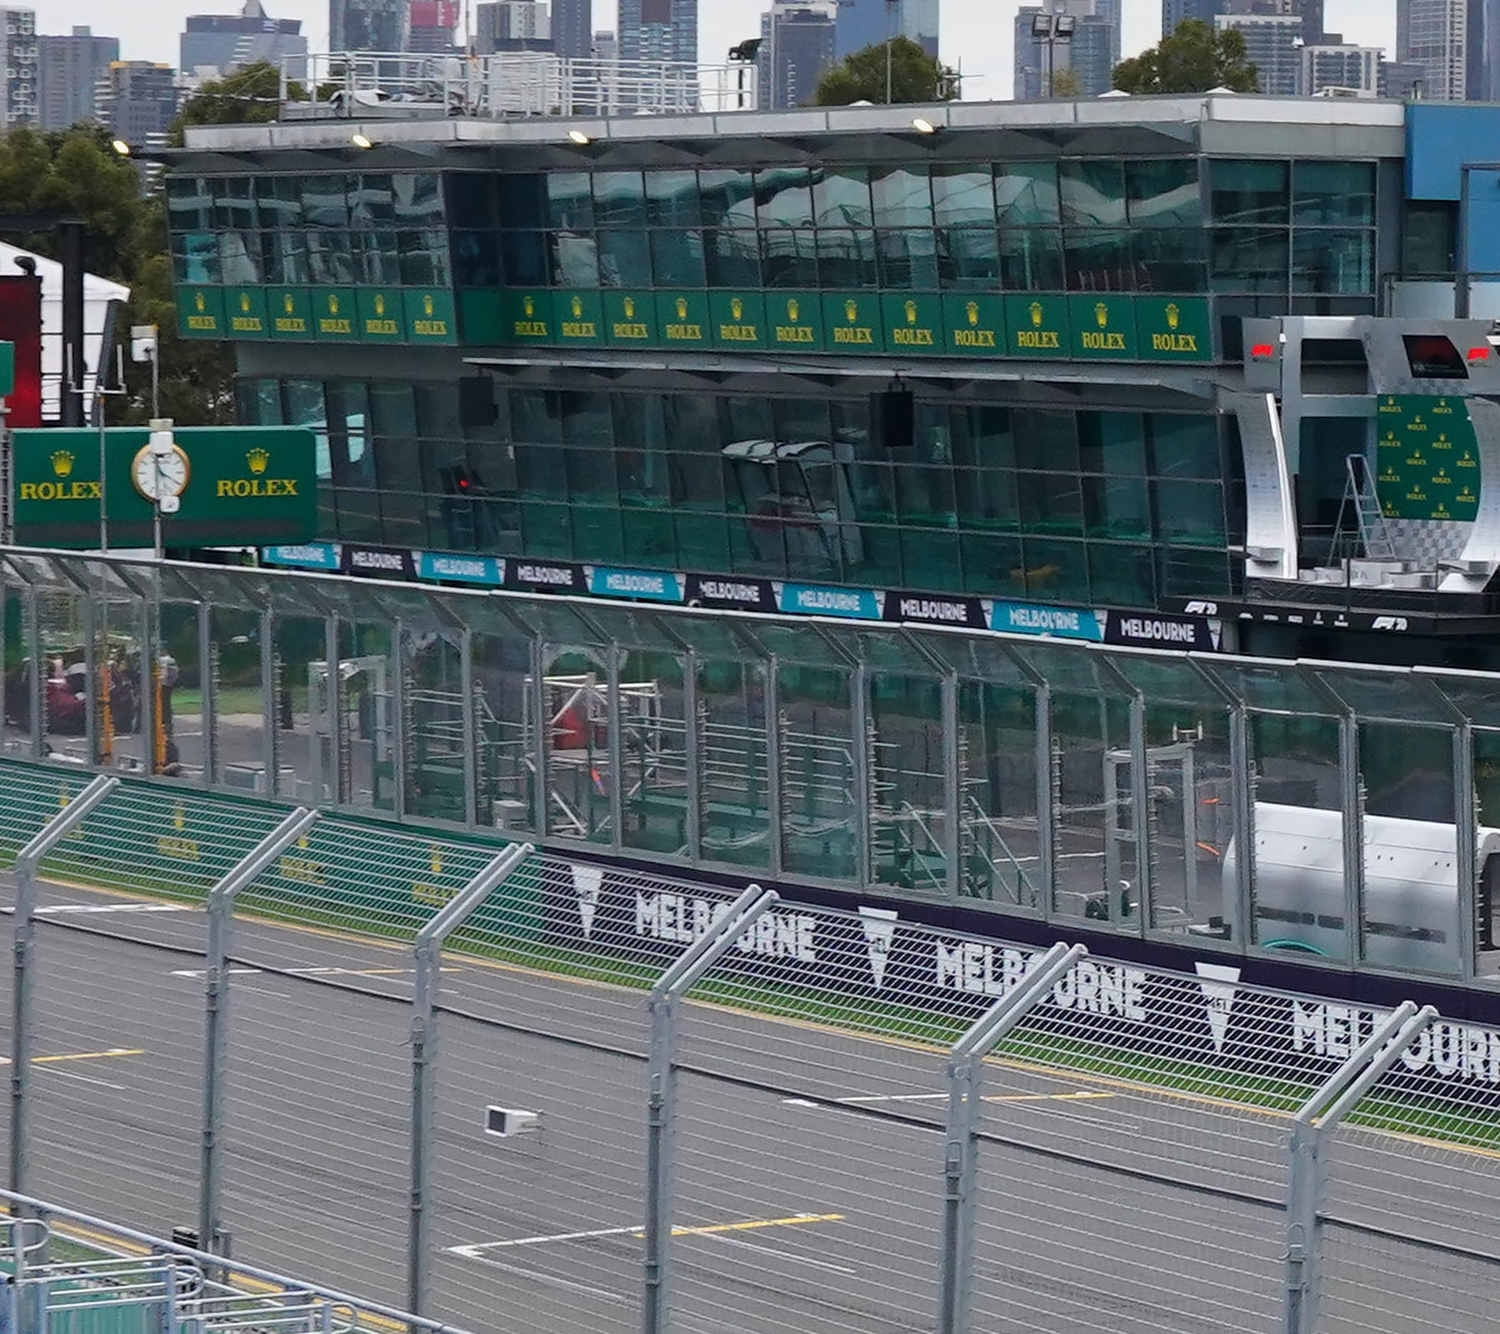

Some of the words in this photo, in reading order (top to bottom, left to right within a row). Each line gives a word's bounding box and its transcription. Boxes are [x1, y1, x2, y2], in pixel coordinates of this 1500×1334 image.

[720, 325, 757, 340] ROLEX
[776, 327, 813, 342] ROLEX
[834, 328, 872, 343] ROLEX
[894, 329, 933, 344] ROLEX
[954, 330, 995, 347] ROLEX
[1018, 331, 1059, 347] ROLEX
[1082, 332, 1125, 349] ROLEX
[1153, 334, 1197, 351] ROLEX
[21, 482, 104, 499] ROLEX
[217, 480, 297, 496] ROLEX
[353, 552, 402, 570] MELBOURNE
[434, 559, 485, 576] MELBOURNE
[518, 566, 572, 585] MELBOURNE
[607, 575, 663, 593] MELBOURNE
[700, 582, 760, 602] MELBOURNE
[798, 591, 860, 611] MELBOURNE
[901, 600, 967, 621] MELBOURNE
[1010, 609, 1079, 630] MELBOURNE
[1121, 619, 1194, 642] MELBOURNE
